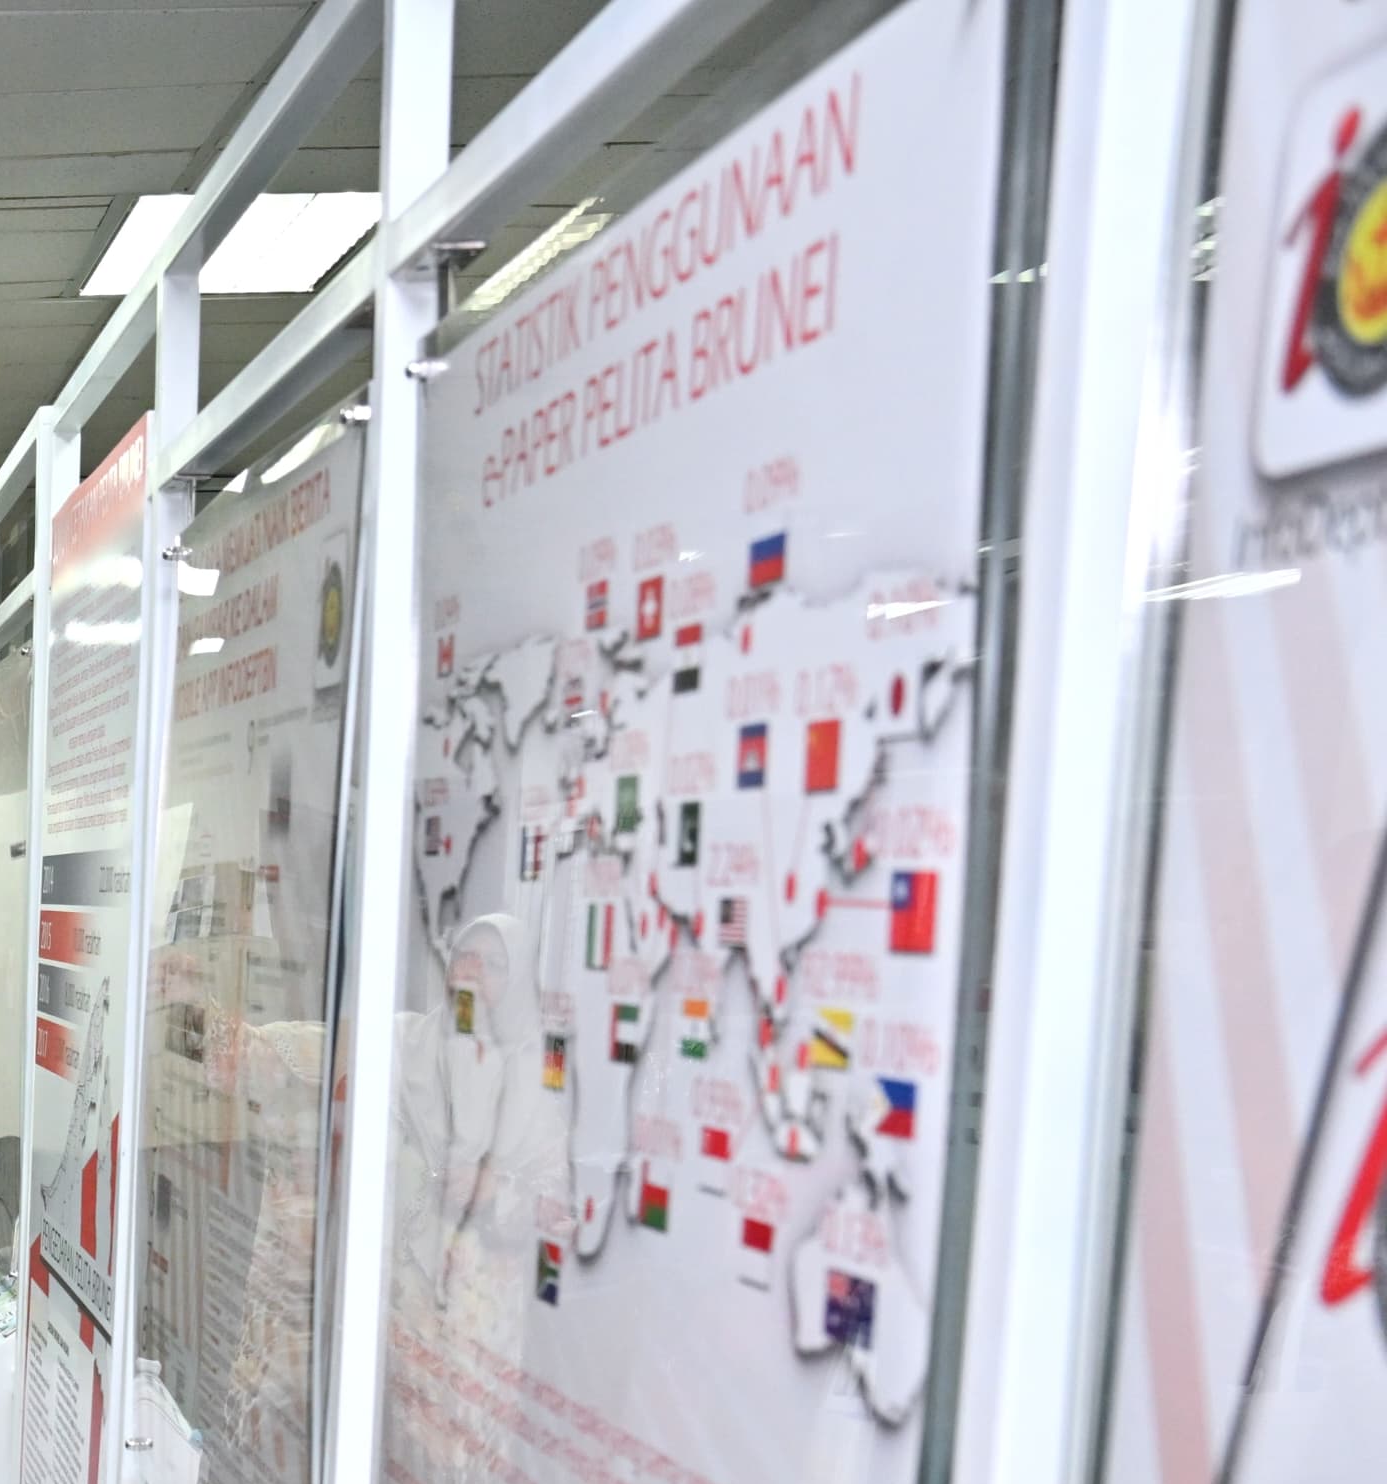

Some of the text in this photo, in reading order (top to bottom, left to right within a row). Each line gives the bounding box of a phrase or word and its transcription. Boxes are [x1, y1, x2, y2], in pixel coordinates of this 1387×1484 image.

[474, 71, 862, 416] STATISTIK PENGGUNAAN
[482, 231, 839, 509] e-PAPER PELITA BRUNEI
[40, 922, 52, 950] 2015
[37, 1026, 49, 1057] 2017
